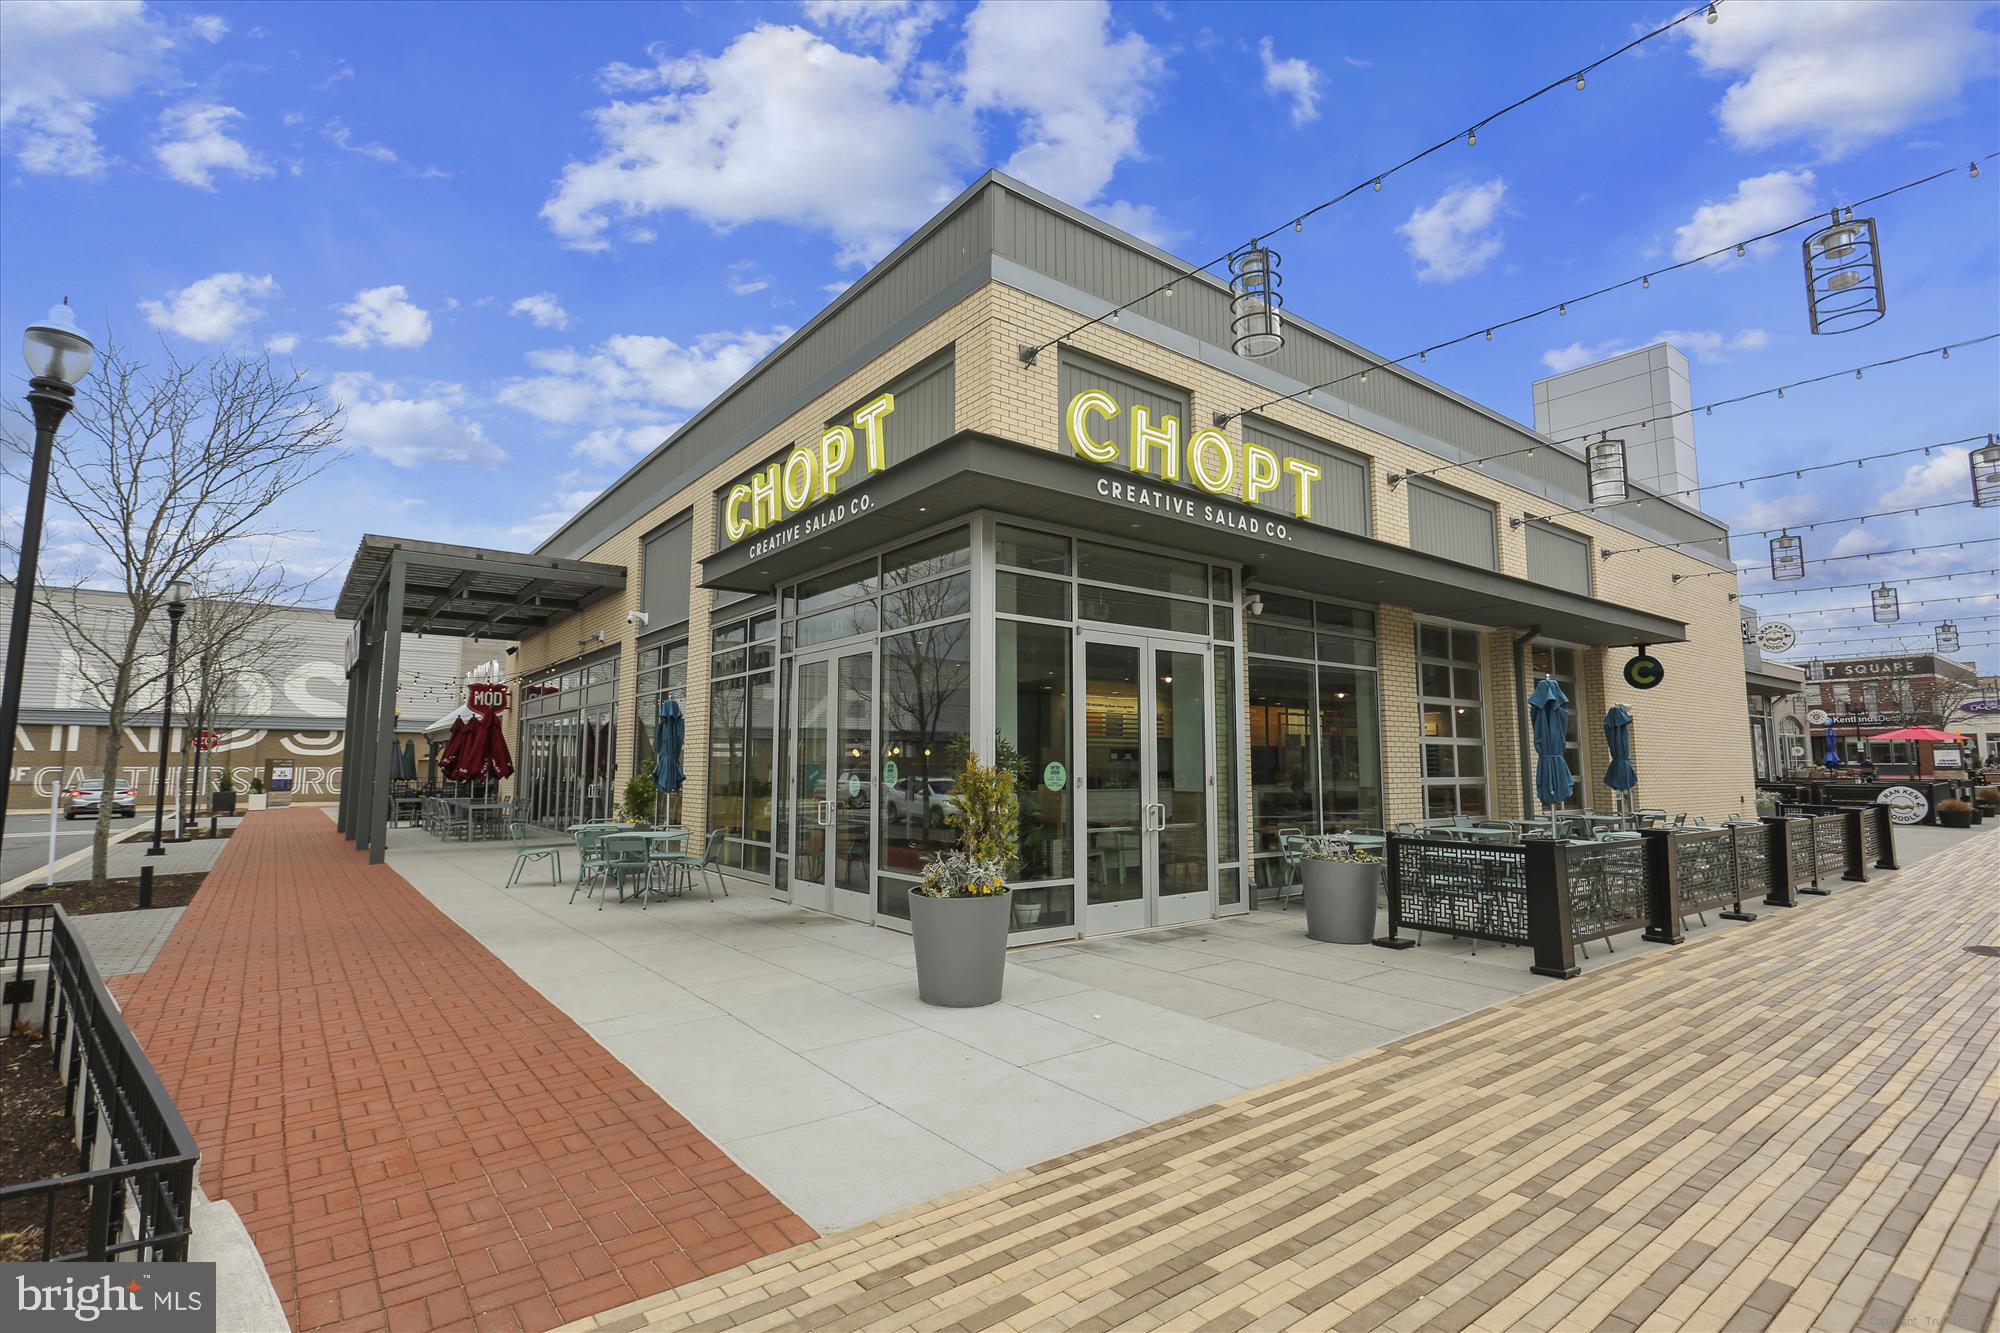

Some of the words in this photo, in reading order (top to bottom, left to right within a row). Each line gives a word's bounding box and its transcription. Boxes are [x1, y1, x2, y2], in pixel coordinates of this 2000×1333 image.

[1066, 389, 1322, 519] CHOPT
[725, 392, 895, 541] CHOPT
[1097, 478, 1195, 517] CREATIVE
[1204, 505, 1259, 533] SALAD
[1265, 521, 1292, 541] CO.
[749, 524, 800, 558] CREATIVE
[805, 504, 845, 534] SALAD
[851, 494, 875, 514] CO.
[1631, 661, 1656, 684] C
[1844, 661, 1915, 675] SQUARE
[474, 691, 503, 706] MOD
[1882, 790, 1900, 799] RAN
[1902, 789, 1920, 800] KEN
[1891, 812, 1921, 822] OODLE
